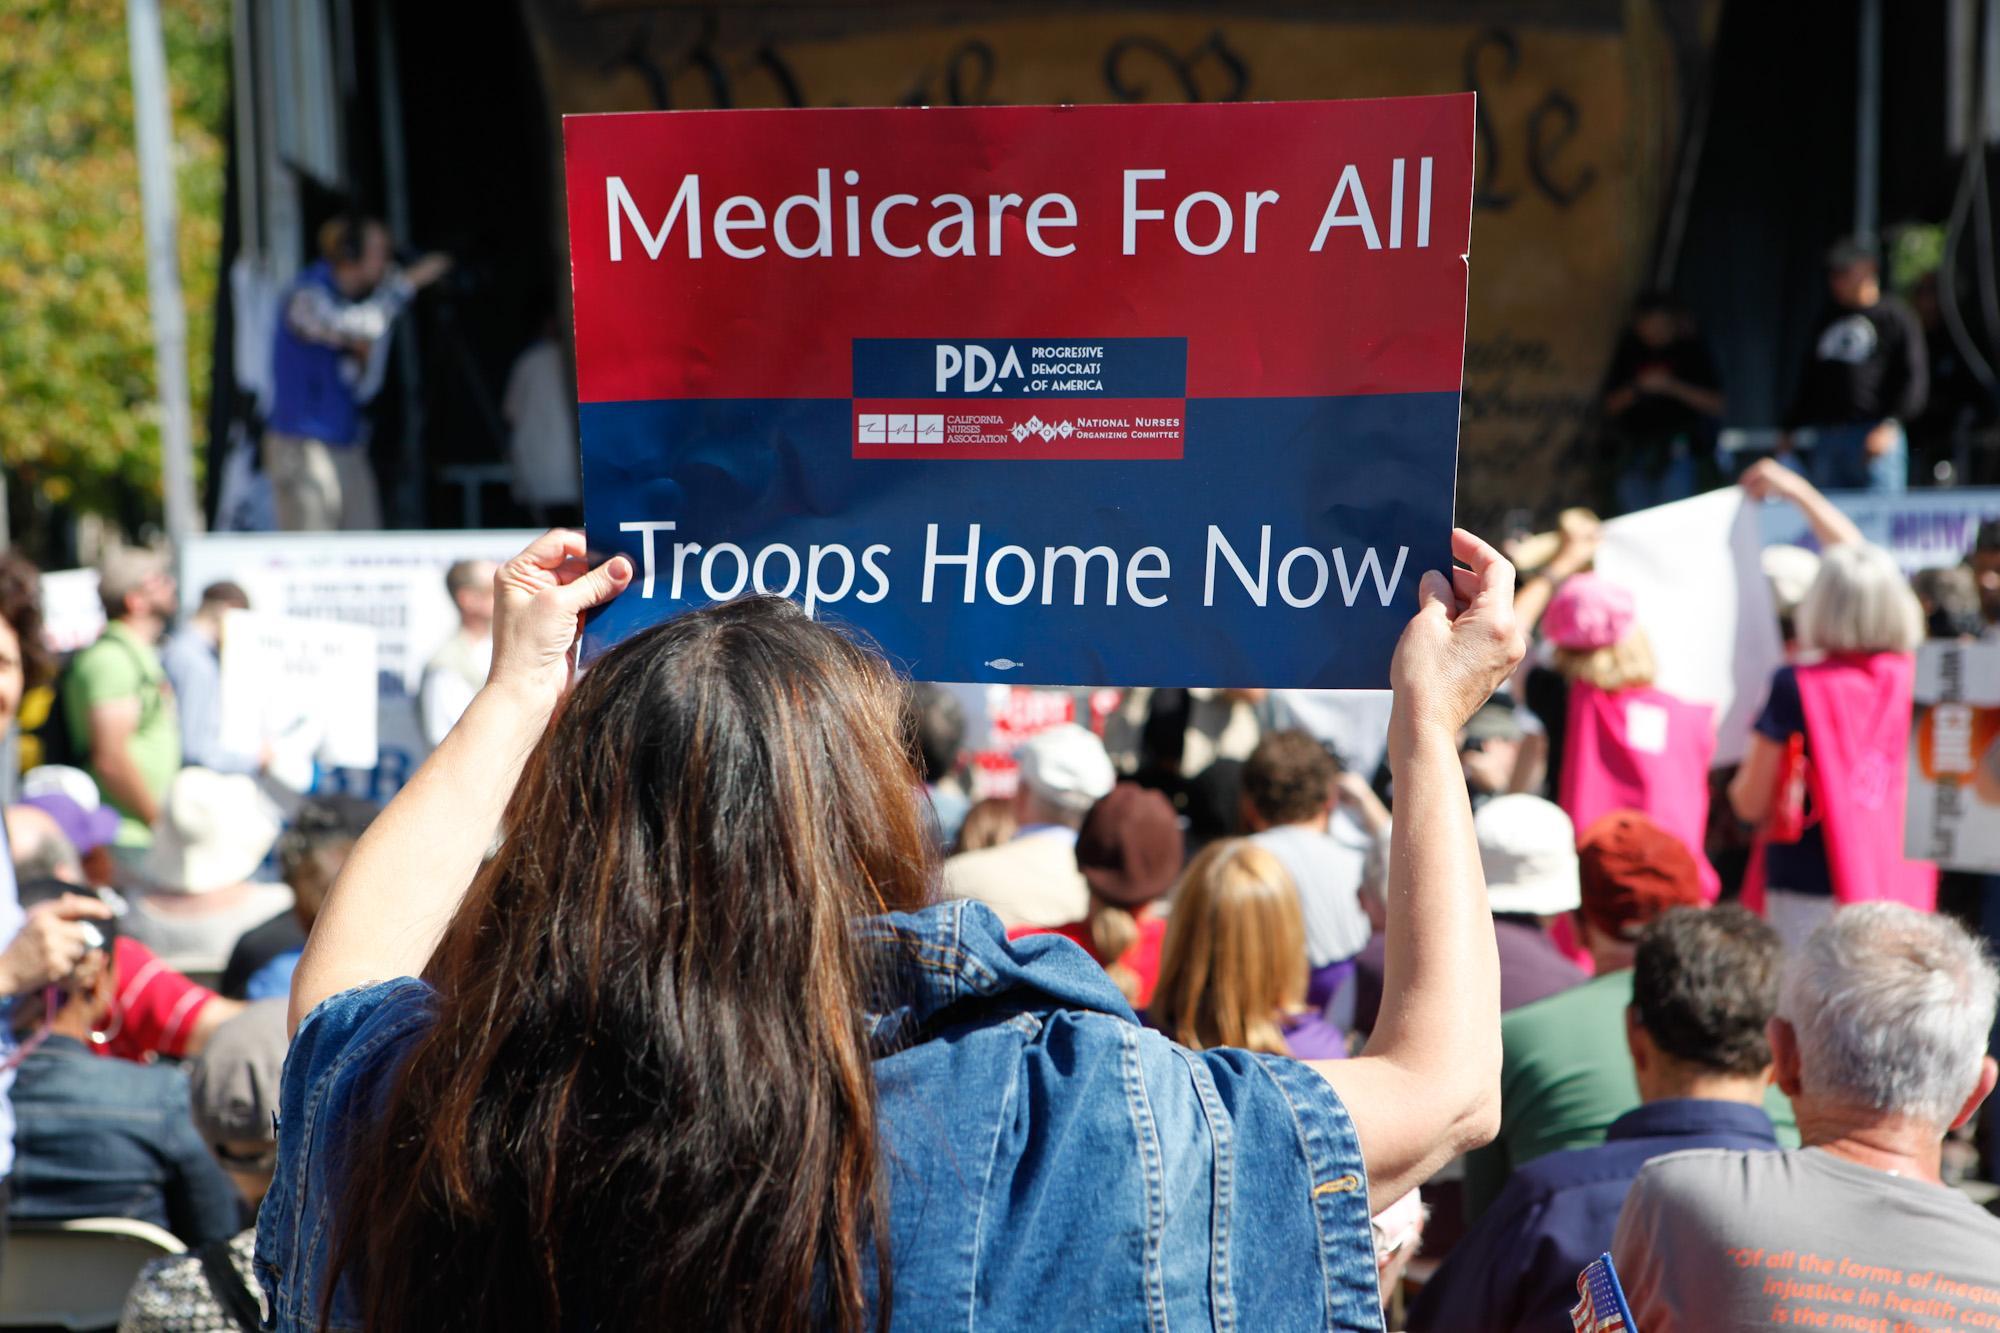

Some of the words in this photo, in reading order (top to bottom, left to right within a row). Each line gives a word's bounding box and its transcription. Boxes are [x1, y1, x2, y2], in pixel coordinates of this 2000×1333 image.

[607, 168, 1077, 261] Medicare
[1123, 169, 1279, 256] For
[1310, 157, 1432, 252] All
[1031, 347, 1104, 358] PROGRESSIVE
[936, 345, 1029, 392] PDA
[1031, 363, 1101, 375] DEMOCRATS
[1031, 380, 1049, 391] OF
[1052, 380, 1103, 391] AMERICA
[947, 415, 1004, 425] CALIFORNIA
[1077, 417, 1130, 427] NATIONAL
[1135, 417, 1180, 427] NURSES
[947, 425, 981, 434] NURSES
[1076, 430, 1128, 439] ORGANIZING
[1131, 430, 1180, 439] COMMITTEE
[947, 434, 1008, 444] ASSOCIATION
[619, 521, 891, 618] Troops
[922, 524, 1170, 608] Home
[1204, 525, 1410, 608] Now
[1765, 1249, 1795, 1269] all
[1798, 1253, 1835, 1275] the
[1838, 1257, 1902, 1284] forms
[1907, 1270, 1935, 1290] of
[1762, 1276, 1855, 1302] injustice
[1858, 1287, 1881, 1307] in
[1884, 1290, 1958, 1320] health
[1771, 1302, 1789, 1324] is
[1793, 1306, 1830, 1327] the
[1832, 1312, 1889, 1333] most
